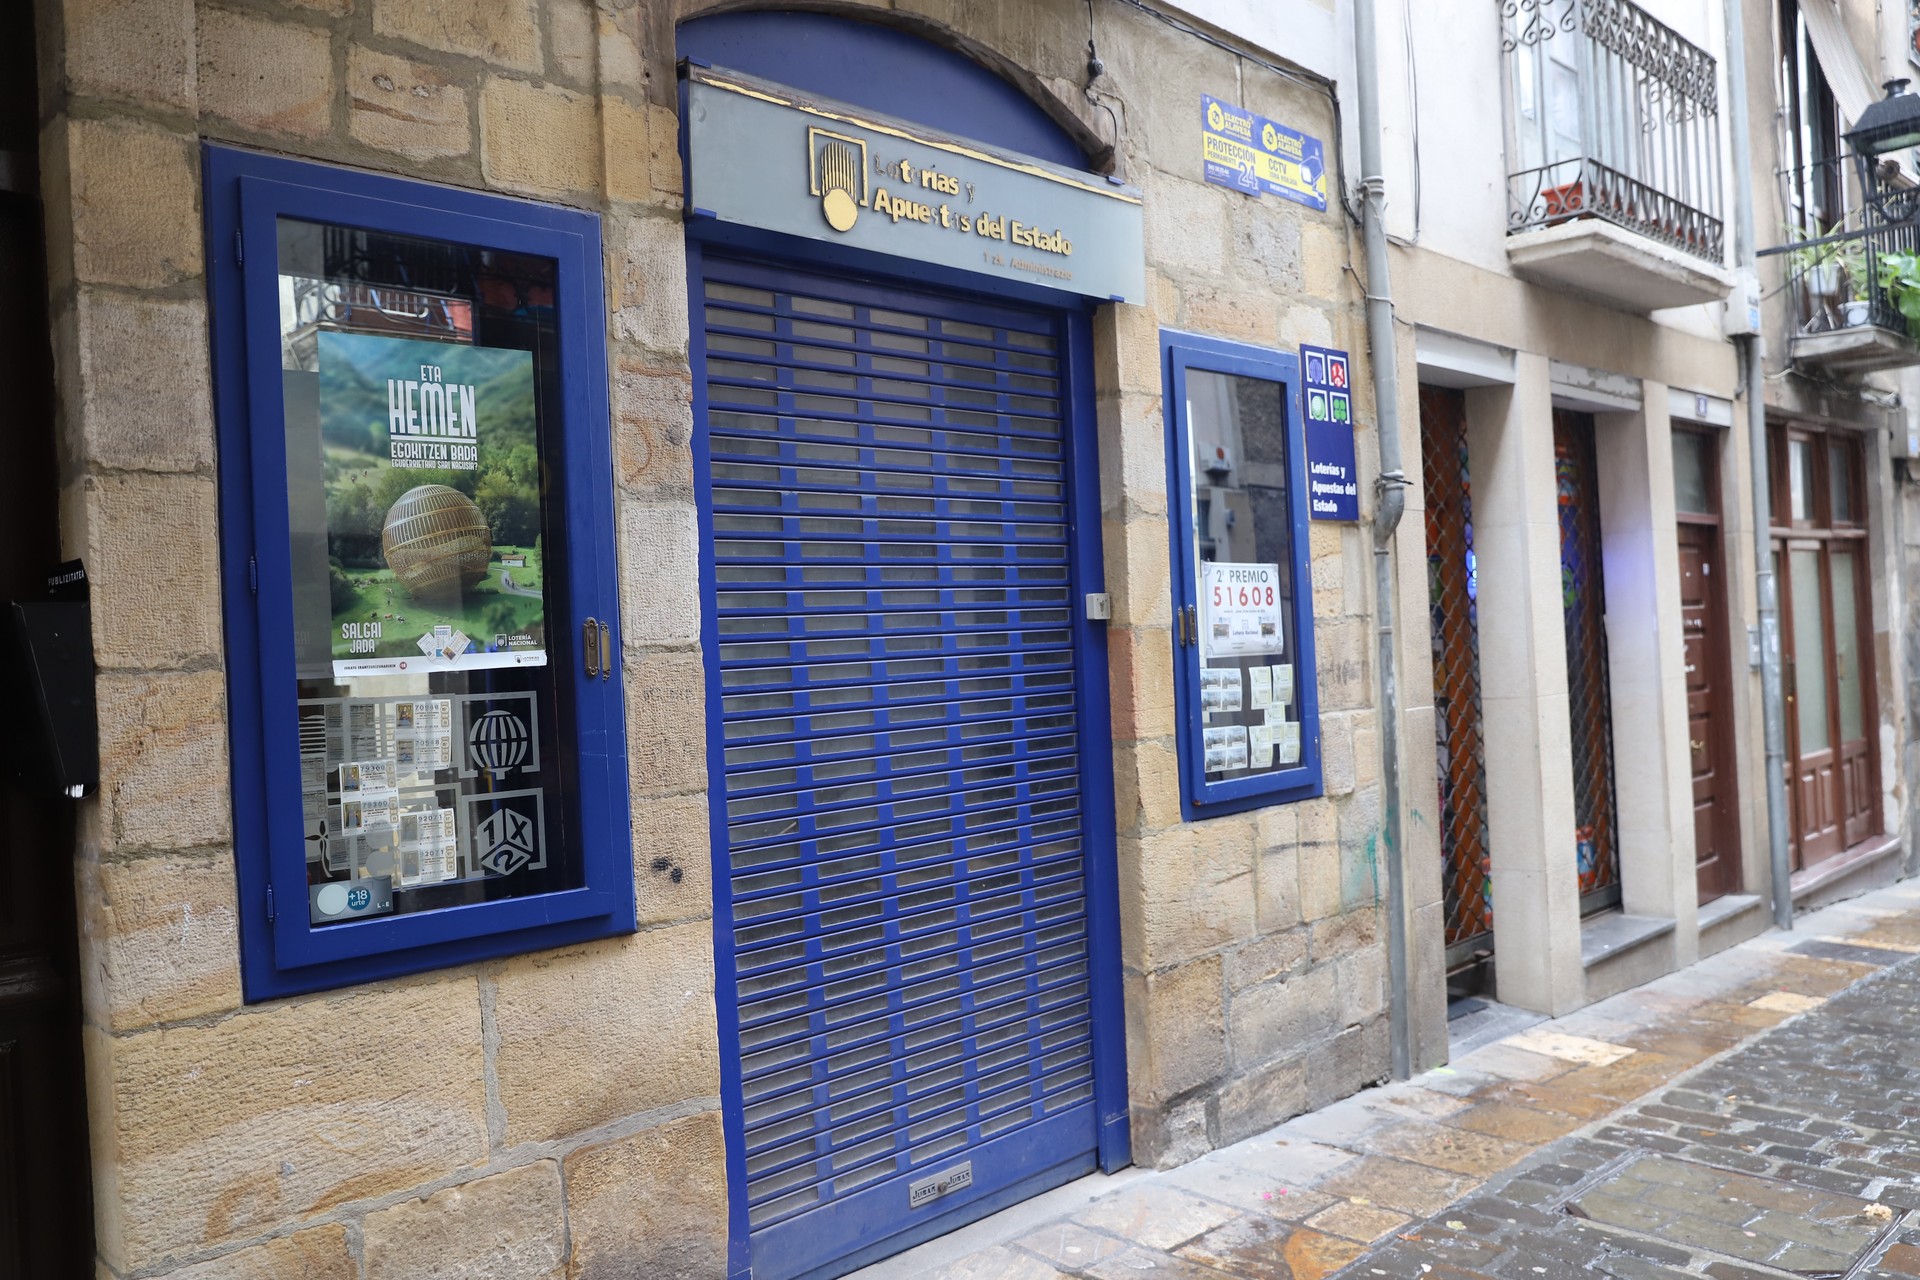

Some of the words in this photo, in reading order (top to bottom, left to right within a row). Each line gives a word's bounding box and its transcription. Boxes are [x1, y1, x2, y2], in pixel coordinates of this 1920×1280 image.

[1207, 136, 1256, 165] PROTECCIÓN
[1238, 160, 1260, 191] 24
[1268, 158, 1287, 175] CCTV
[976, 211, 1006, 241] del
[1010, 218, 1073, 256] Estado
[420, 364, 442, 382] ETA
[387, 378, 477, 437] HEMEN
[390, 441, 448, 460] EGOKITZEN
[450, 444, 478, 461] BADA
[1310, 461, 1340, 476] Loterías
[1340, 466, 1346, 480] y
[1312, 480, 1344, 496] Apuestas
[1345, 482, 1356, 496] del
[1313, 499, 1338, 513] Estado
[48, 570, 85, 586] PUBLIZITATEA
[1229, 569, 1269, 583] PREMIO
[1213, 586, 1274, 607] 51608
[341, 621, 382, 640] SALGAI
[508, 633, 532, 641] LOTERÍA
[349, 639, 376, 654] JADA
[348, 889, 369, 901] +18
